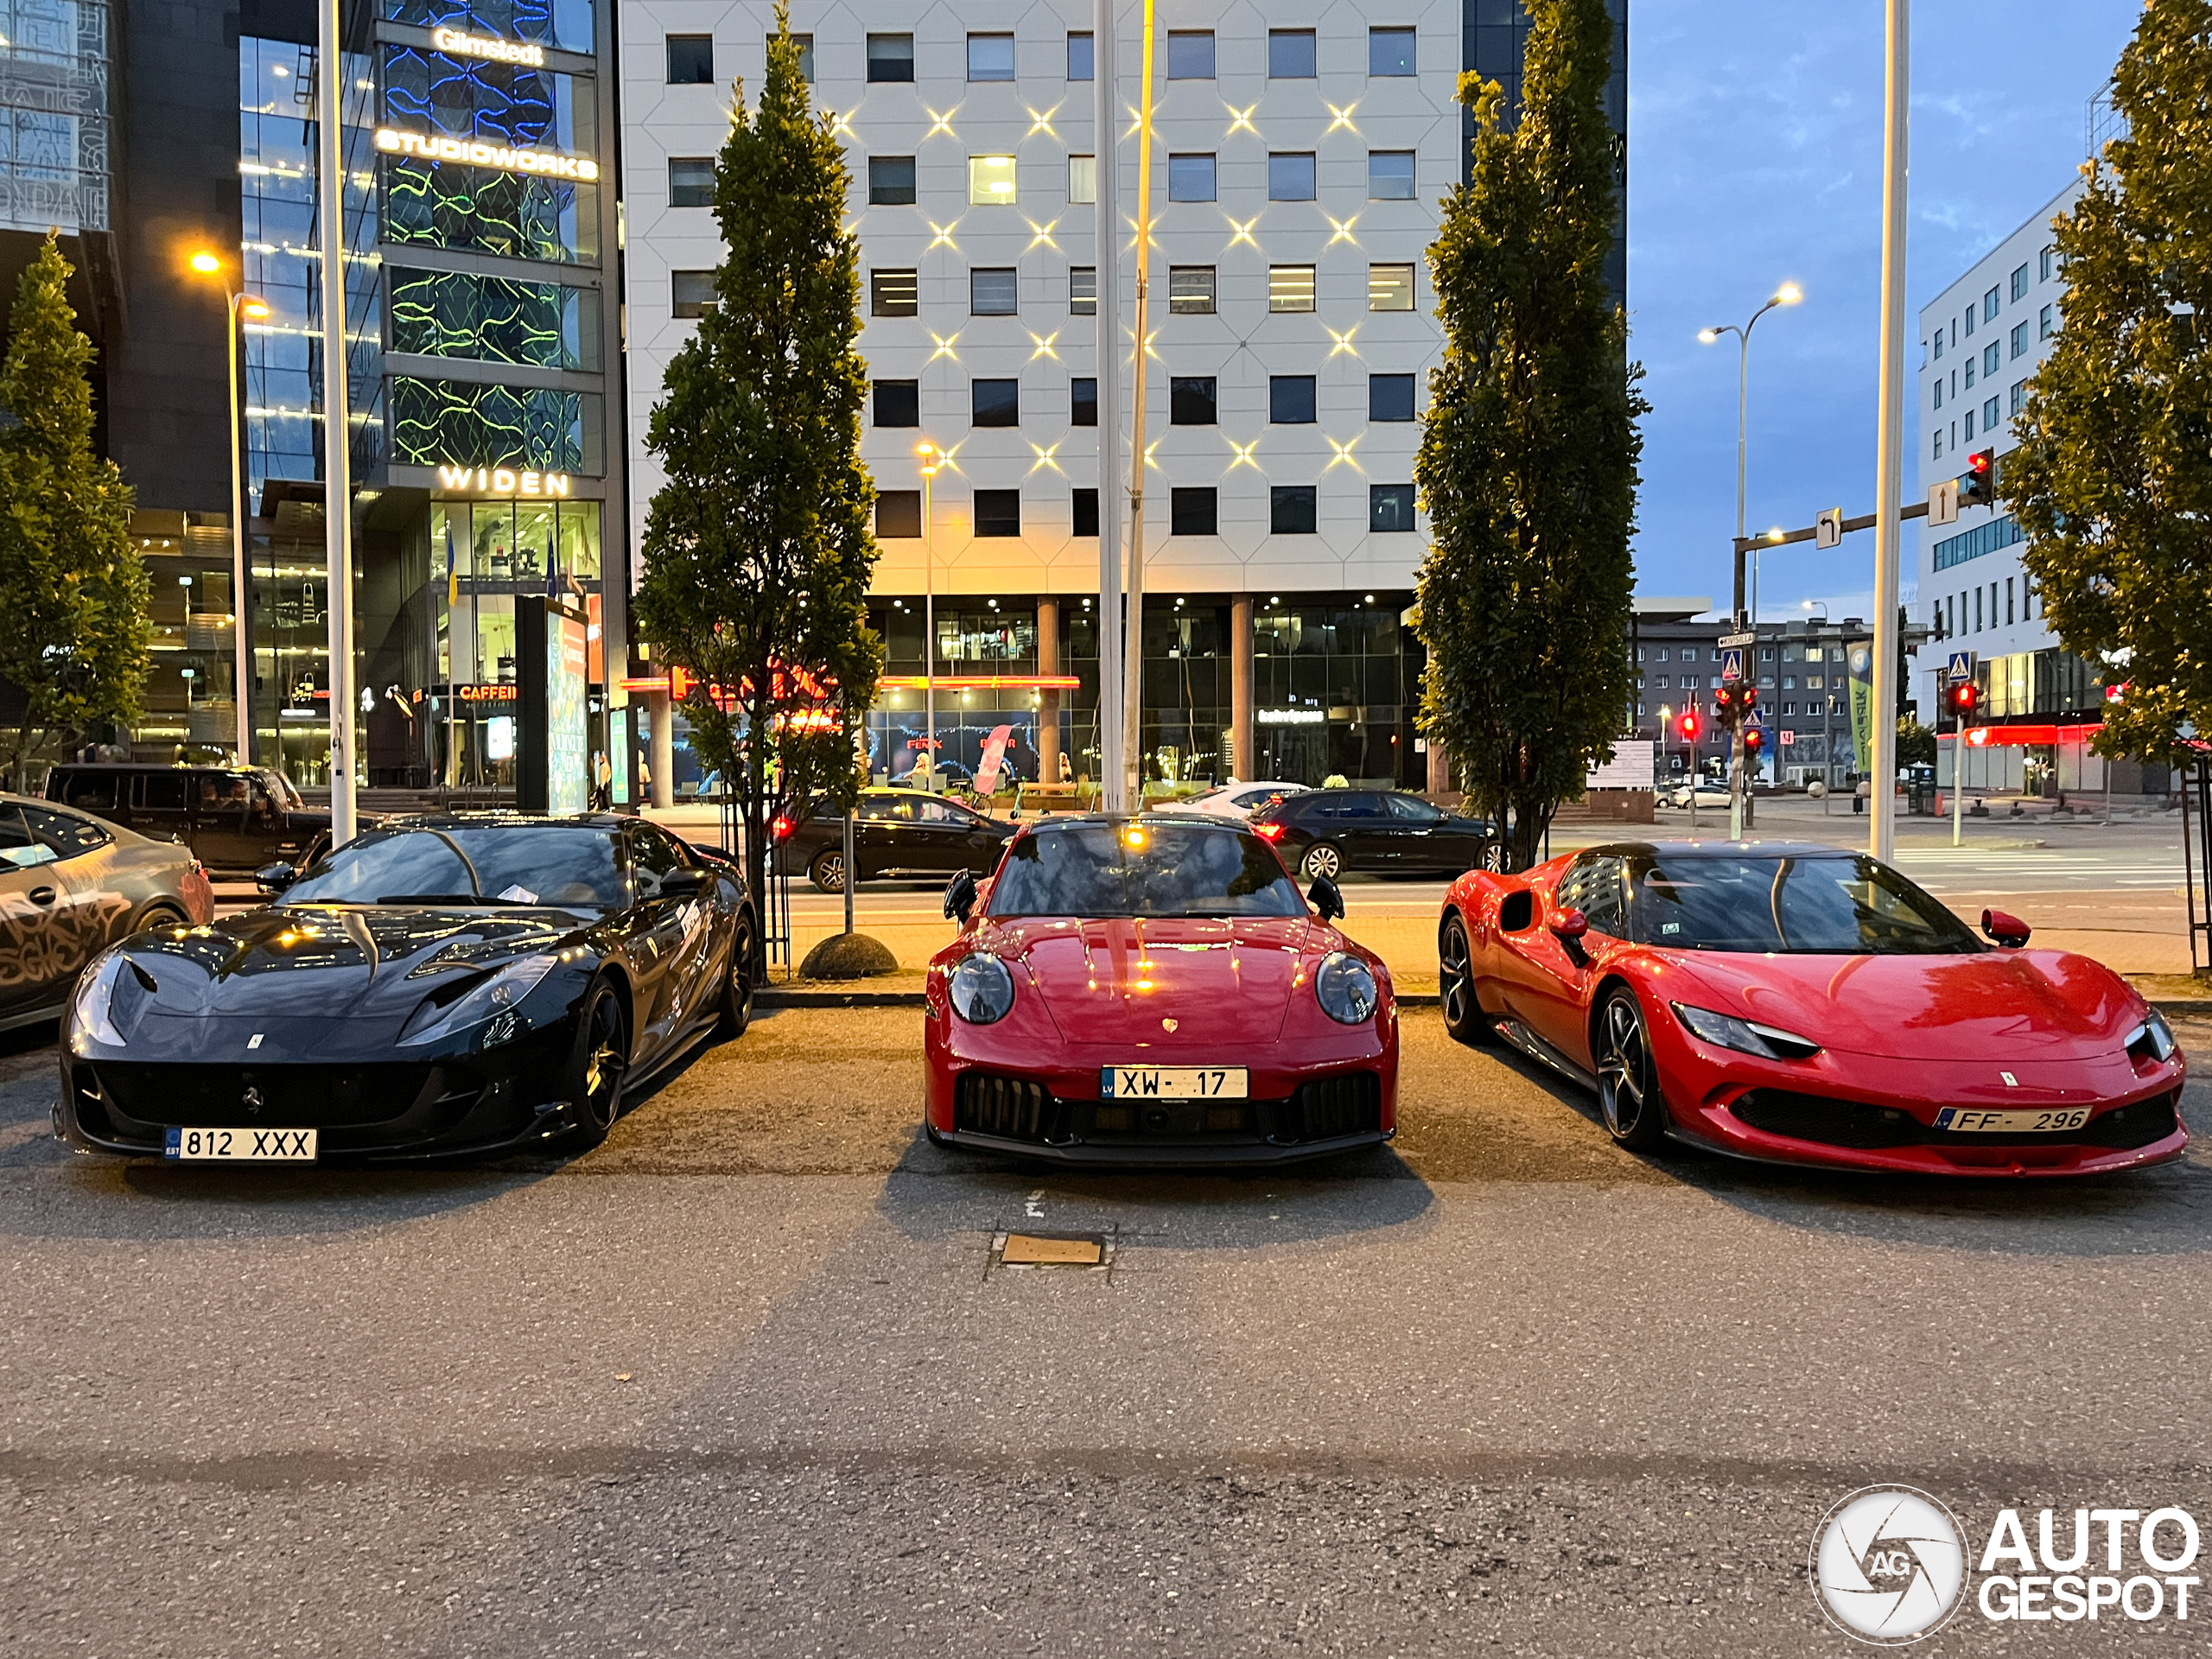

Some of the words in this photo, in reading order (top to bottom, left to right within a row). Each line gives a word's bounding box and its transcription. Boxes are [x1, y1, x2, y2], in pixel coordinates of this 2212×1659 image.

[434, 28, 543, 67] Glimstedt
[376, 129, 599, 181] STUDIOWORKS
[439, 465, 569, 497] WIDEN
[906, 738, 943, 750] FENX
[1198, 1071, 1226, 1095] 17
[2032, 1110, 2085, 1130] 296
[165, 1146, 180, 1155] EST
[187, 1131, 233, 1156] 812
[251, 1131, 309, 1156] XXX
